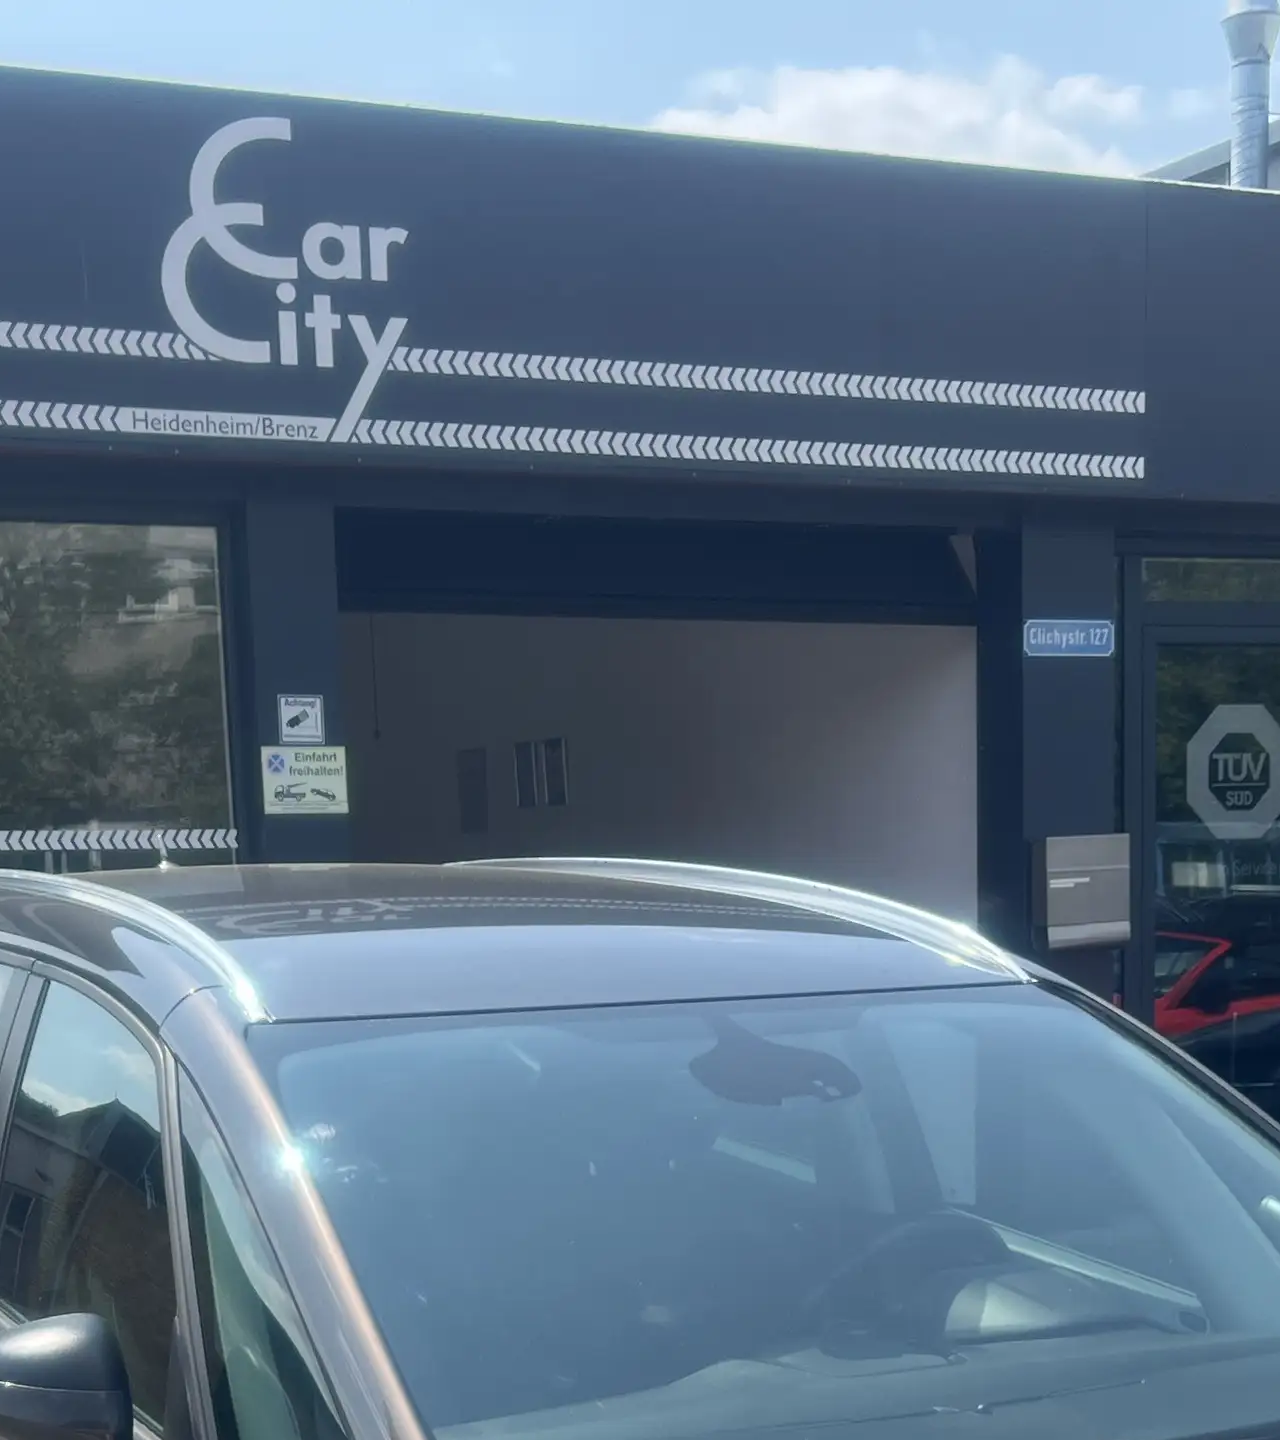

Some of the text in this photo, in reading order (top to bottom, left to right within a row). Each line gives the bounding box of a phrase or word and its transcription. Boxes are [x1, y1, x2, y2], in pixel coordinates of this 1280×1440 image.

[161, 203, 410, 443] City
[131, 411, 319, 440] Heidenheim/Brenz
[1089, 627, 1109, 646] 127
[294, 752, 338, 763] Einfahrt
